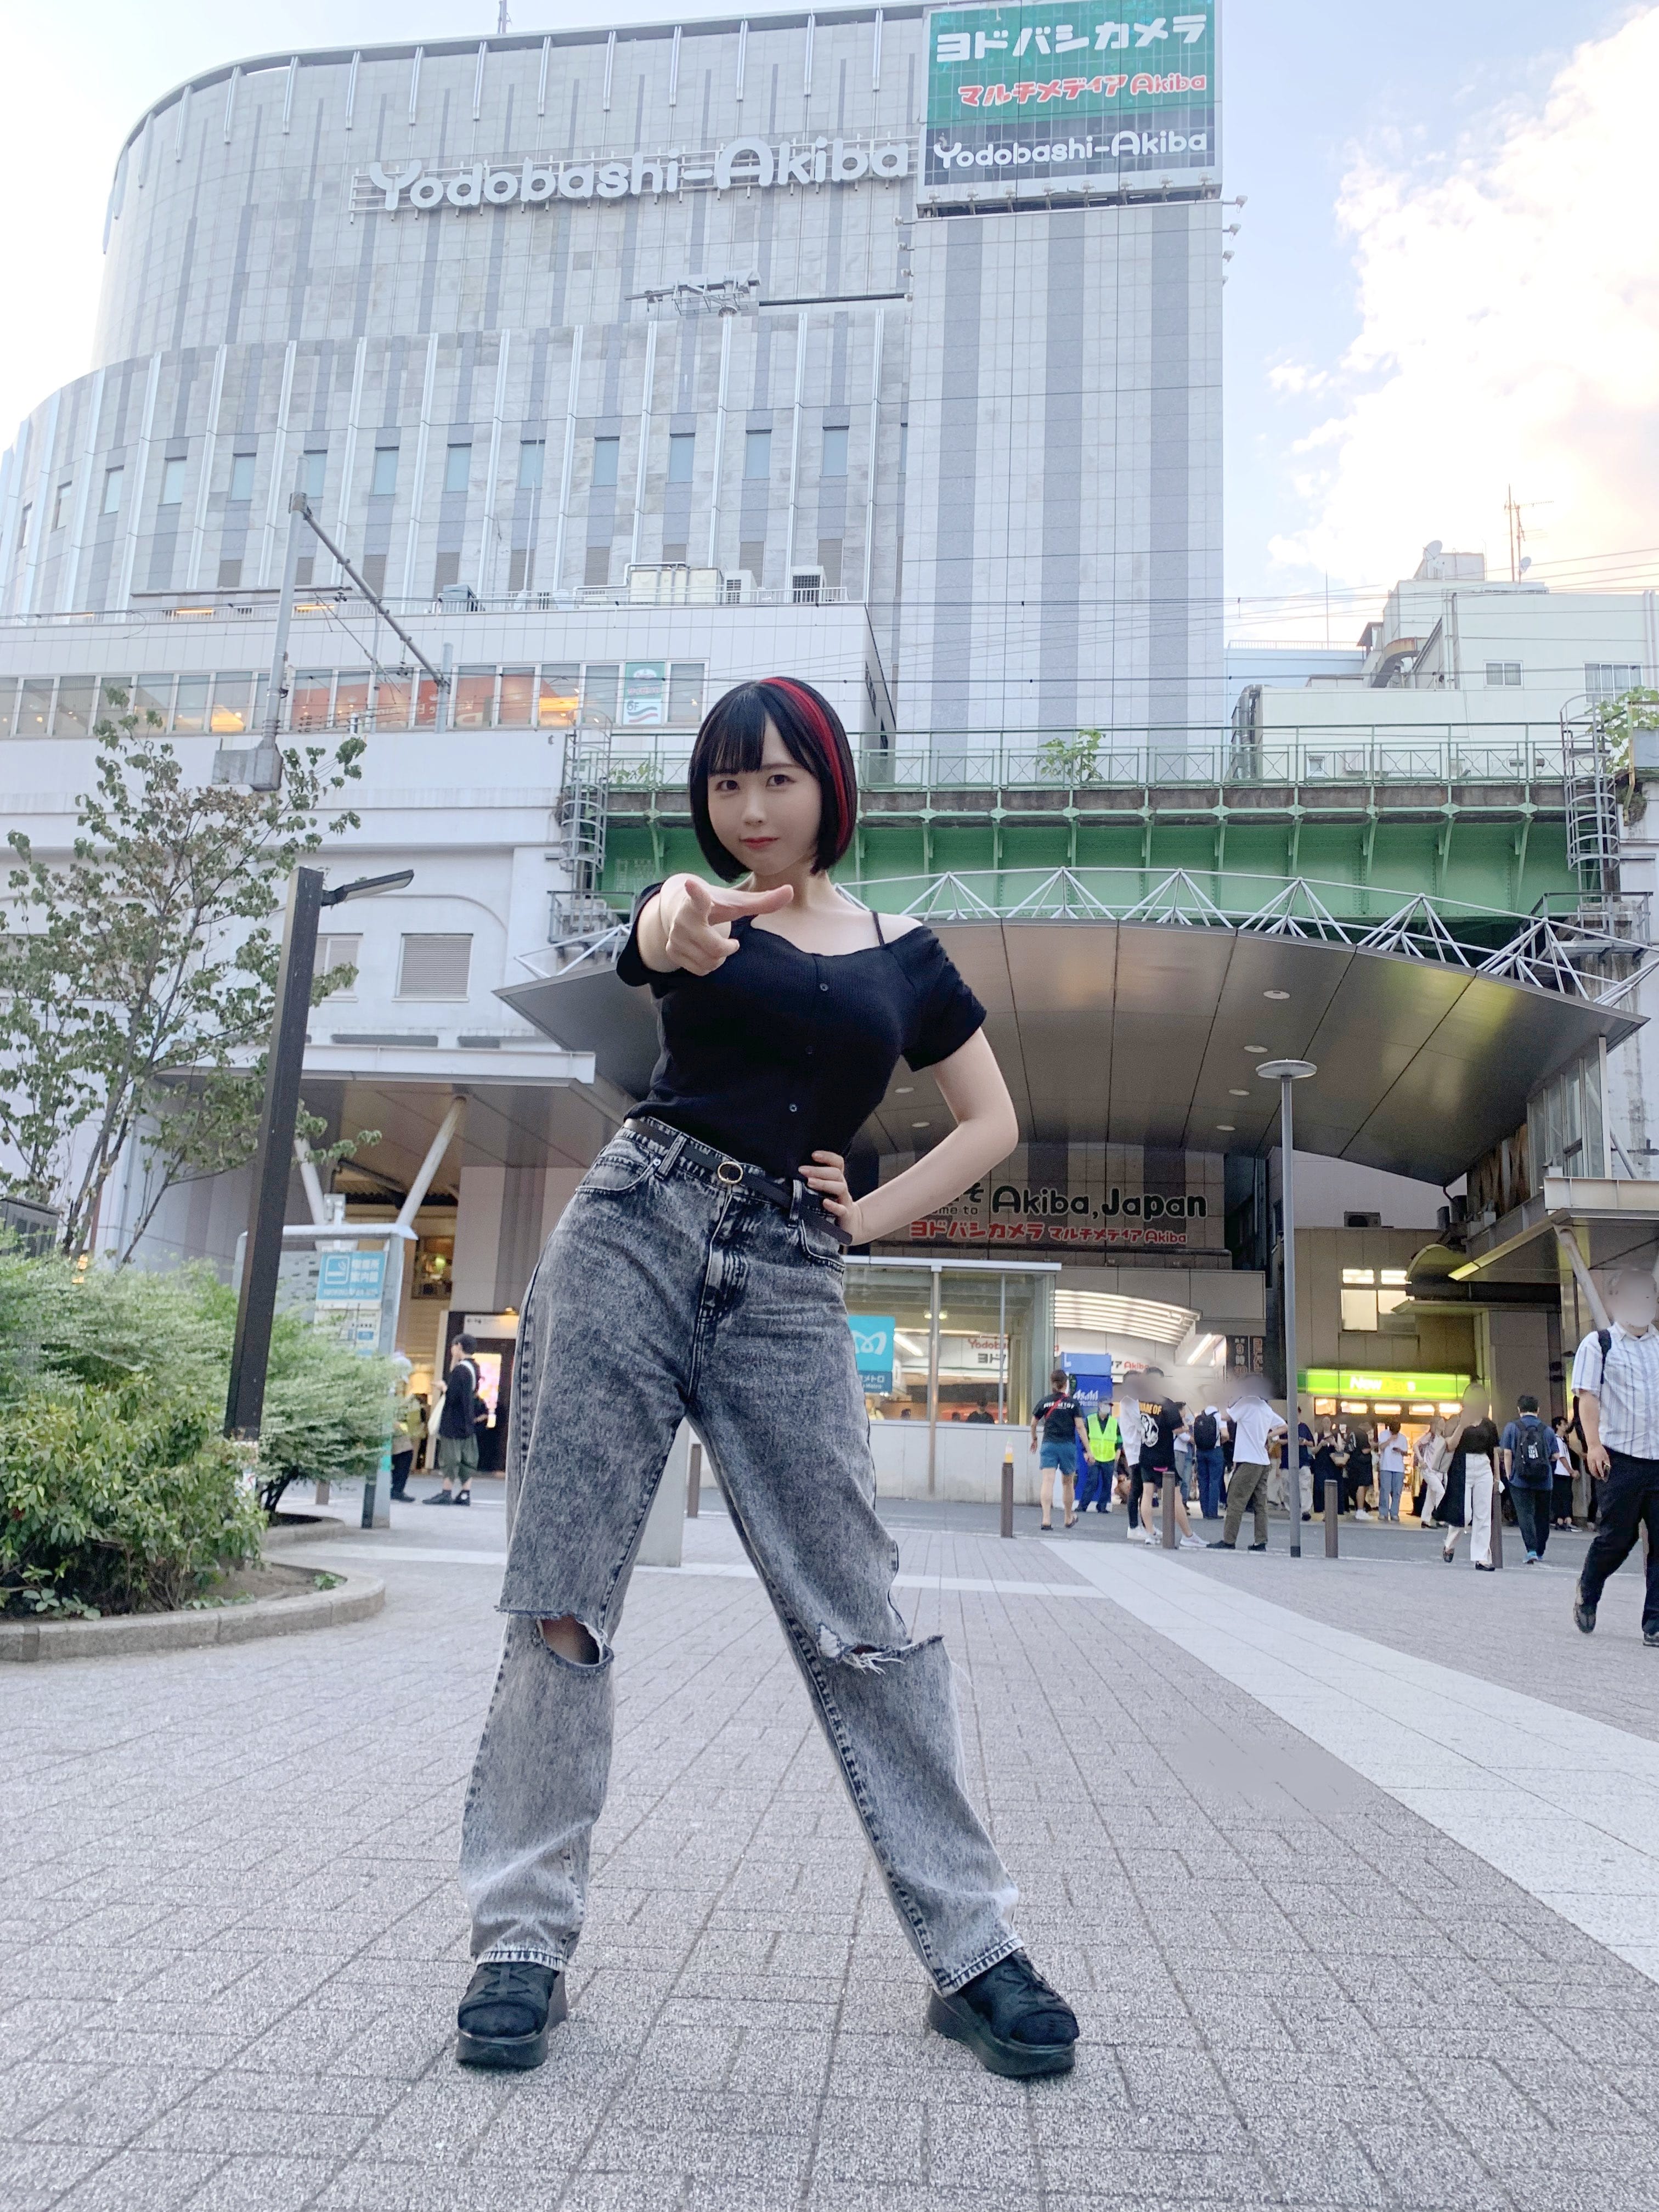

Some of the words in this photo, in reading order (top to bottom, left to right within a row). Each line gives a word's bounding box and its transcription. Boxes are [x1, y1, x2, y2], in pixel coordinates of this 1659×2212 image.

[936, 14, 1207, 63] ヨドバシカメラ
[958, 74, 1128, 107] マルチメディア
[1130, 72, 1207, 96] Akiba
[933, 130, 1207, 169] Yodobashi-Akiba
[369, 137, 909, 211] Yodobashi-Akiba
[963, 1205, 979, 1215] to
[910, 1220, 1045, 1241] ヨドバシカメラ
[1144, 1229, 1187, 1244] Akiba
[859, 1374, 885, 1383] メトロ
[1350, 1375, 1417, 1392] NewDays
[1073, 1389, 1099, 1401] Asahi
